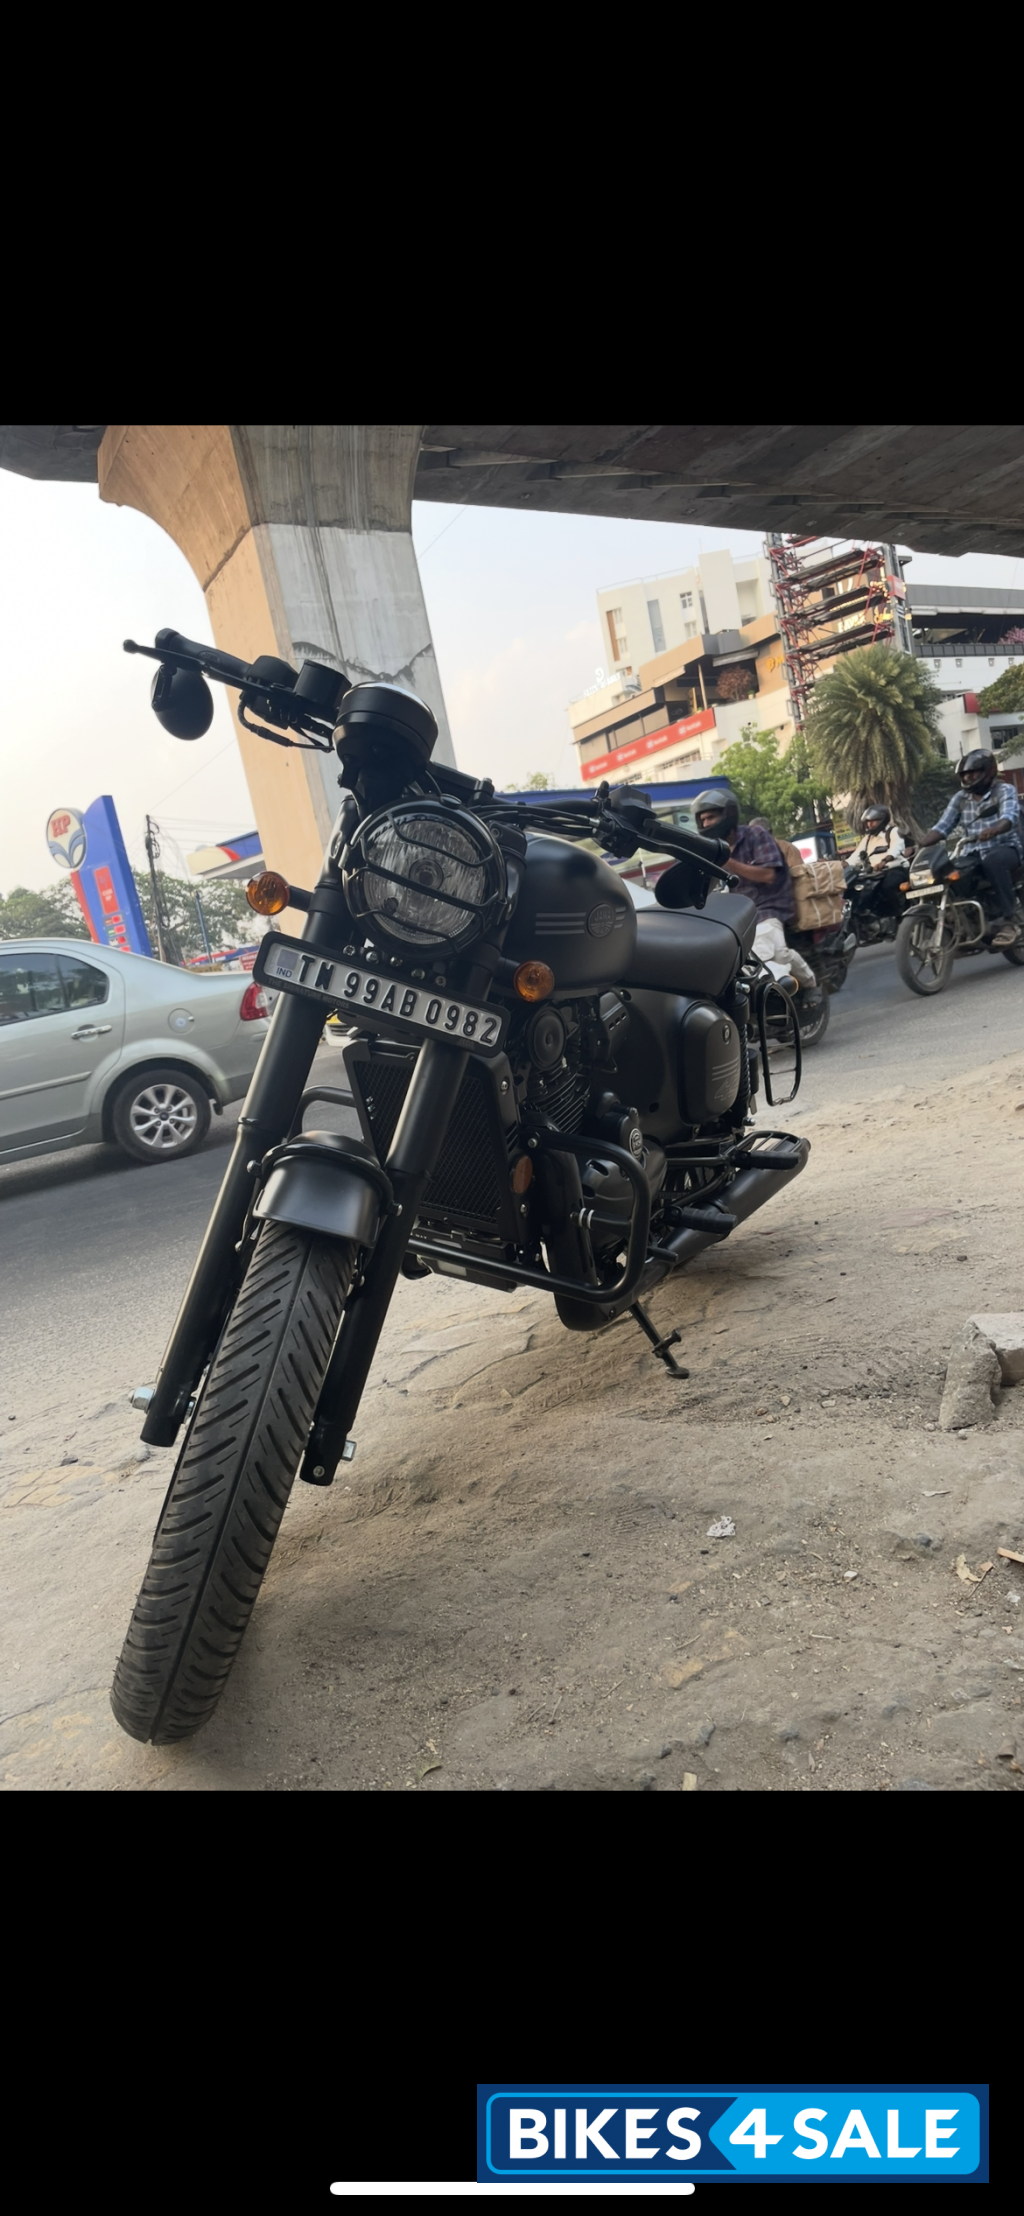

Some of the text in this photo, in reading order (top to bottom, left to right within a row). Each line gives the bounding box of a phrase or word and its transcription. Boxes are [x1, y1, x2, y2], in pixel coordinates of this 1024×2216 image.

[51, 814, 71, 838] HP
[275, 967, 292, 978] IND
[268, 979, 350, 1009] THE SIGNATURE MOTORS
[299, 954, 334, 990] TN
[425, 999, 497, 1044] 0982
